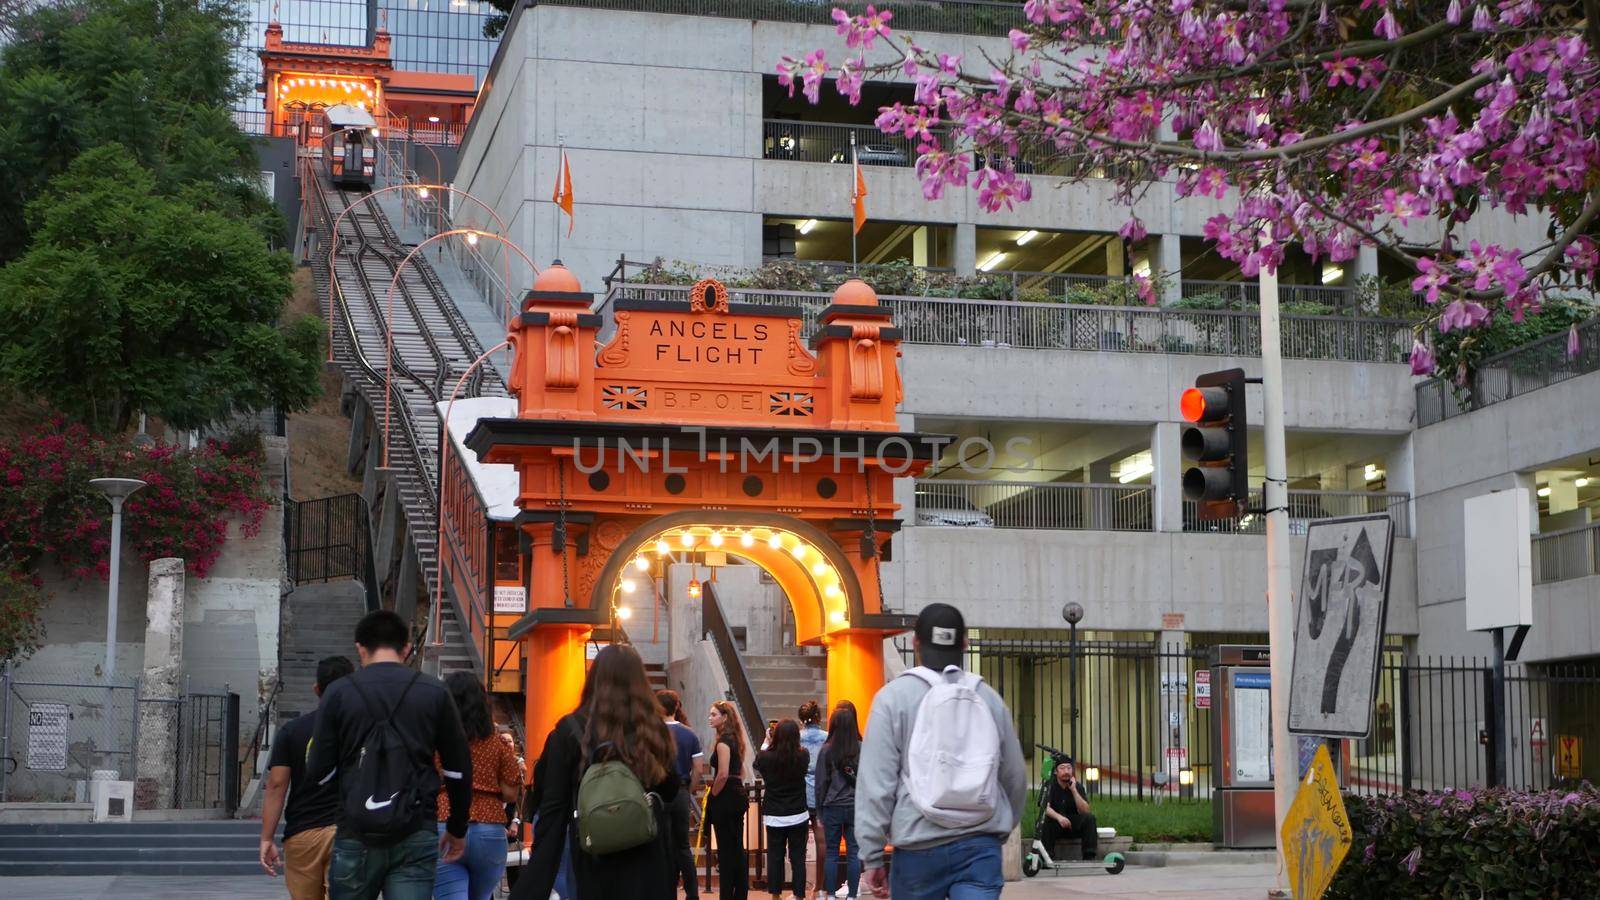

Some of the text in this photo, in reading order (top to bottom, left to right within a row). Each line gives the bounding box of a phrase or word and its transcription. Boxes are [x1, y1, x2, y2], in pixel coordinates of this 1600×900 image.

[650, 319, 768, 341] ANGELS
[656, 344, 763, 365] FLIGHT
[1197, 685, 1205, 695] NO
[30, 713, 41, 725] NO
